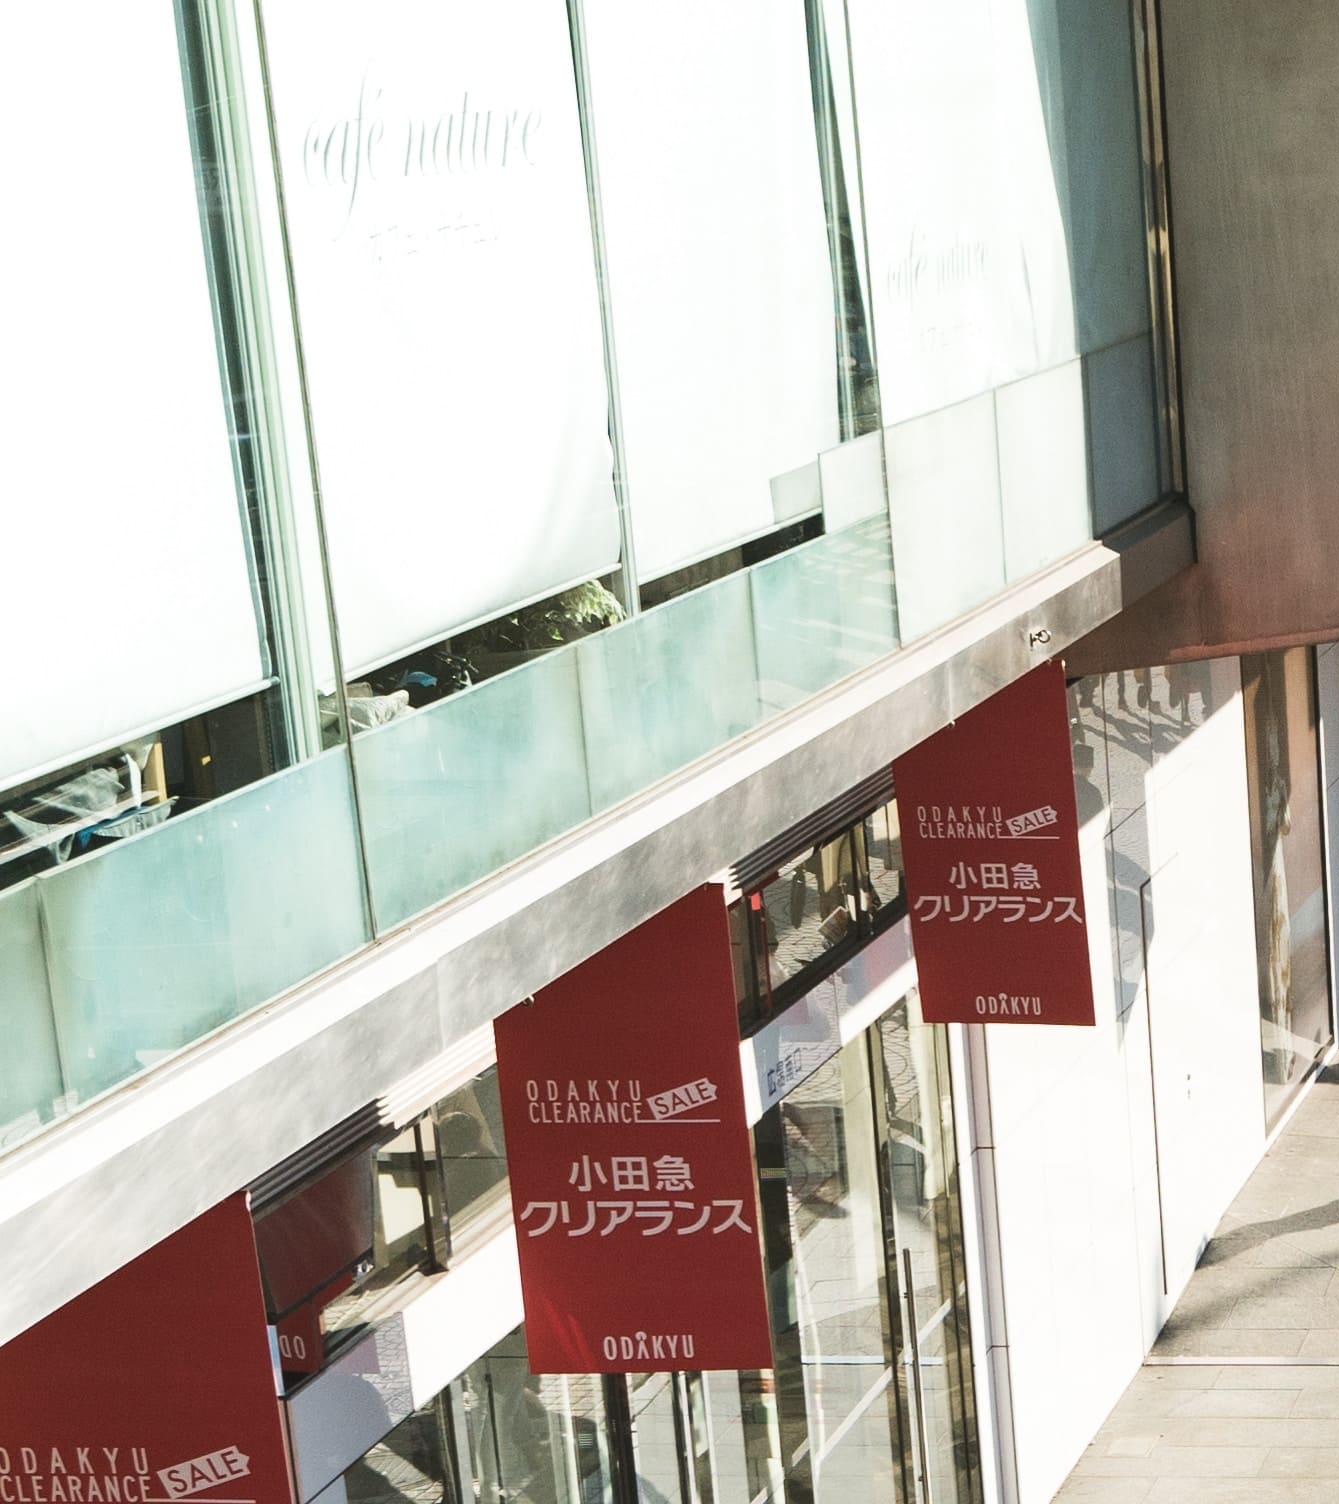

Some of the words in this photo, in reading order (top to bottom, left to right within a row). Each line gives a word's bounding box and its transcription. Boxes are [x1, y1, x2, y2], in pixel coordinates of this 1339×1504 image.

[916, 805, 1002, 823] ODAKYU
[1010, 808, 1054, 834] SALE
[918, 822, 1003, 840] CLEARANCE
[949, 861, 1041, 890] 小田急
[914, 895, 1083, 924] クリアランス
[975, 993, 1042, 1016] ODAKYU
[526, 1079, 642, 1102] ODAKYU
[653, 1081, 711, 1116] SALE
[528, 1102, 643, 1124] CLEARANCE
[568, 1154, 696, 1193] 小田急
[520, 1199, 753, 1238] クリアランス
[603, 1331, 696, 1362] ODAKYU
[166, 1450, 244, 1495] SALE
[2, 1474, 151, 1504] CLEARANCE
